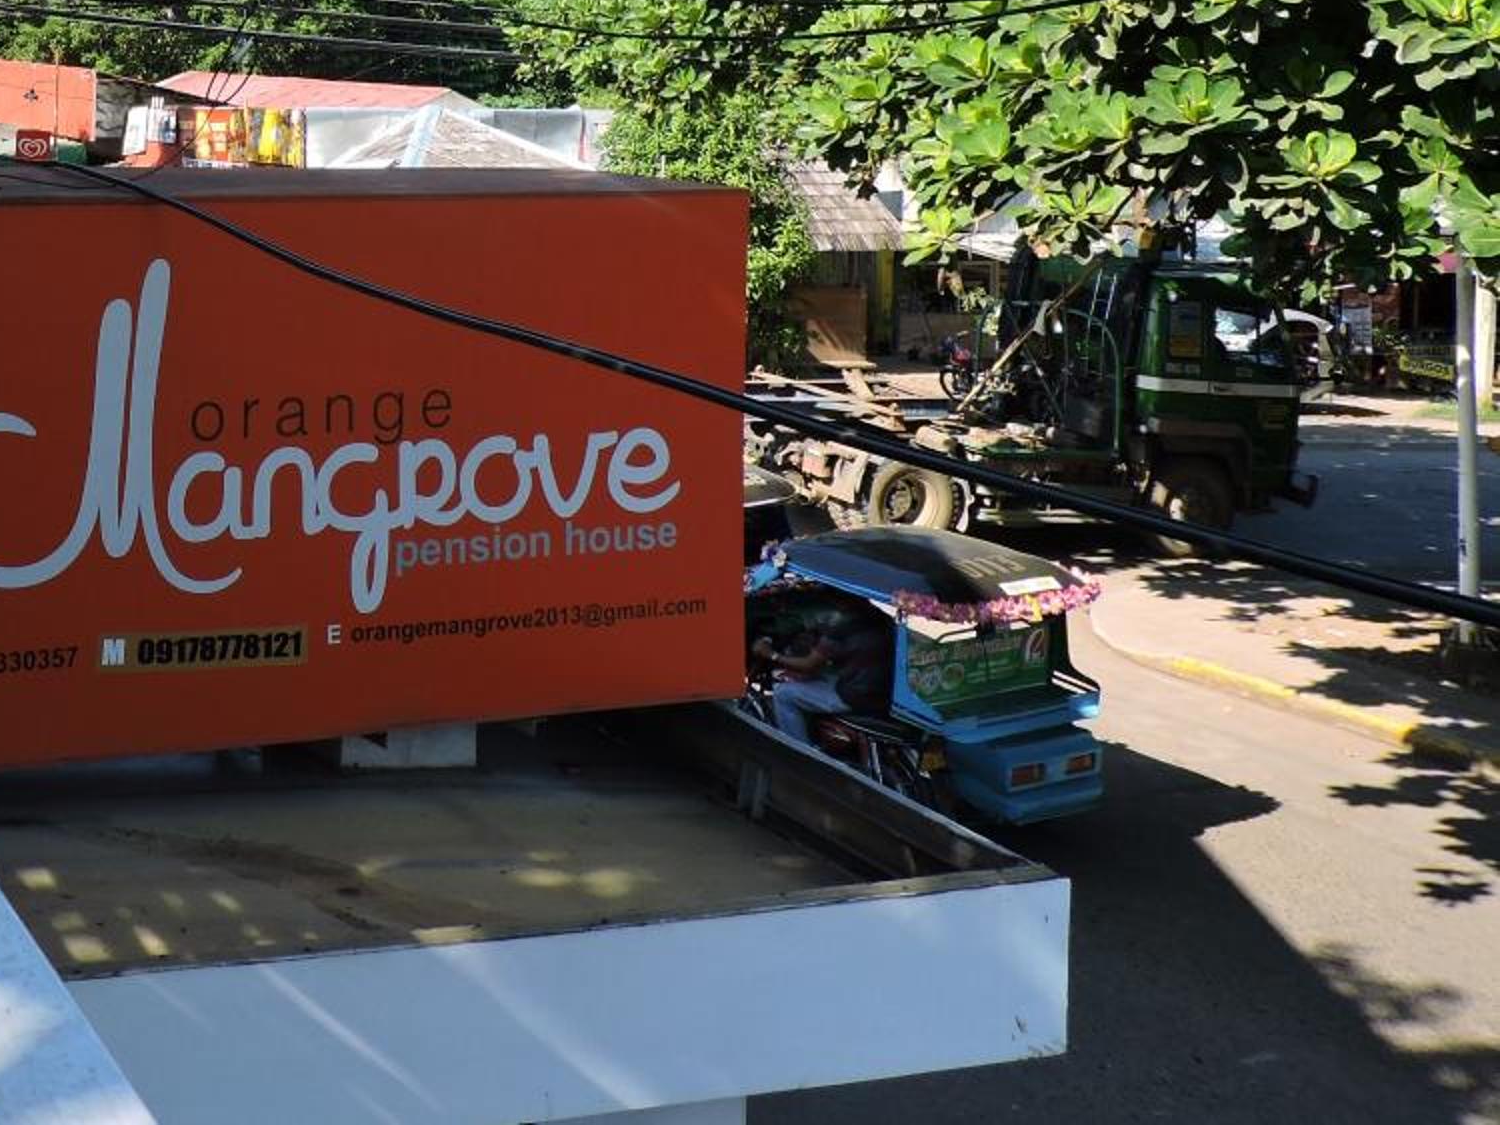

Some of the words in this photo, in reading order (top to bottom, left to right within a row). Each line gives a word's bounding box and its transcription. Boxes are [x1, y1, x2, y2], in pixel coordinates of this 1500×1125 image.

[191, 387, 453, 444] orange
[396, 525, 551, 577] pension
[564, 520, 677, 557] house
[327, 624, 341, 646] E
[350, 596, 707, 644] orangemangrove2013@gmail.com
[101, 638, 126, 666] M
[137, 631, 303, 666] 09178778121
